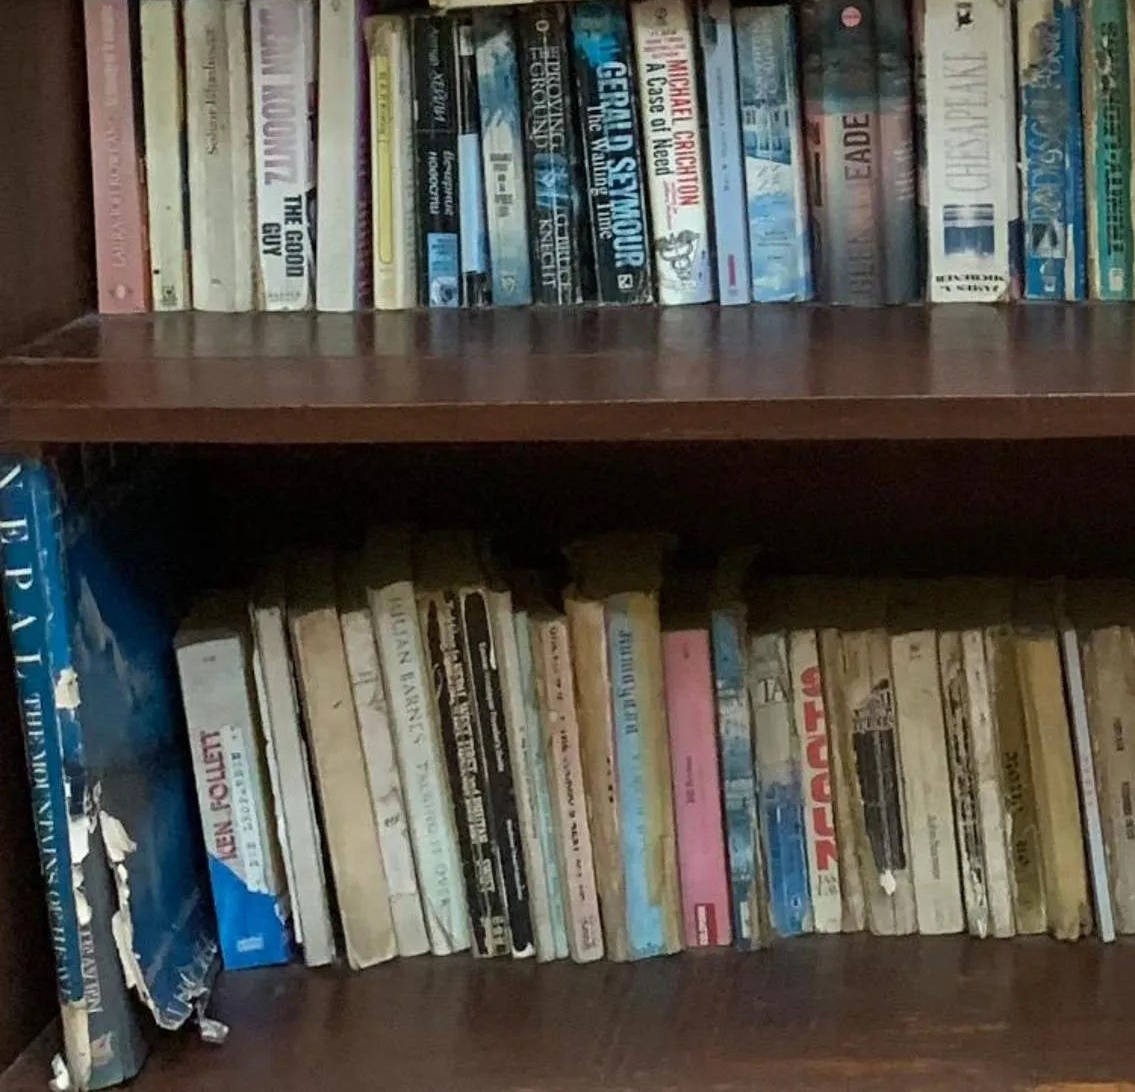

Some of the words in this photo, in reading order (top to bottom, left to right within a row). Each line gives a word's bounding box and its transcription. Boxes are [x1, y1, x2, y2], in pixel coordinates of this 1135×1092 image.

[646, 63, 663, 74] A
[649, 76, 667, 114] Case
[667, 59, 689, 127] MICHAEL
[261, 85, 298, 186] KOONTZ
[529, 62, 547, 149] GROUND
[545, 58, 566, 150] PROVING
[596, 60, 635, 149] GERALD
[652, 119, 671, 134] of
[942, 52, 990, 193] CHESAPEAKE
[654, 138, 674, 176] Need
[672, 130, 700, 206] CRICHTON
[261, 222, 283, 257] GUY
[284, 195, 303, 225] THE
[607, 156, 645, 267] SEYMOUR
[285, 229, 305, 278] GOOD
[538, 219, 556, 289] KNECHT
[397, 672, 426, 745] BARNES
[200, 730, 232, 814] FOLLETT
[212, 822, 237, 860] KEN
